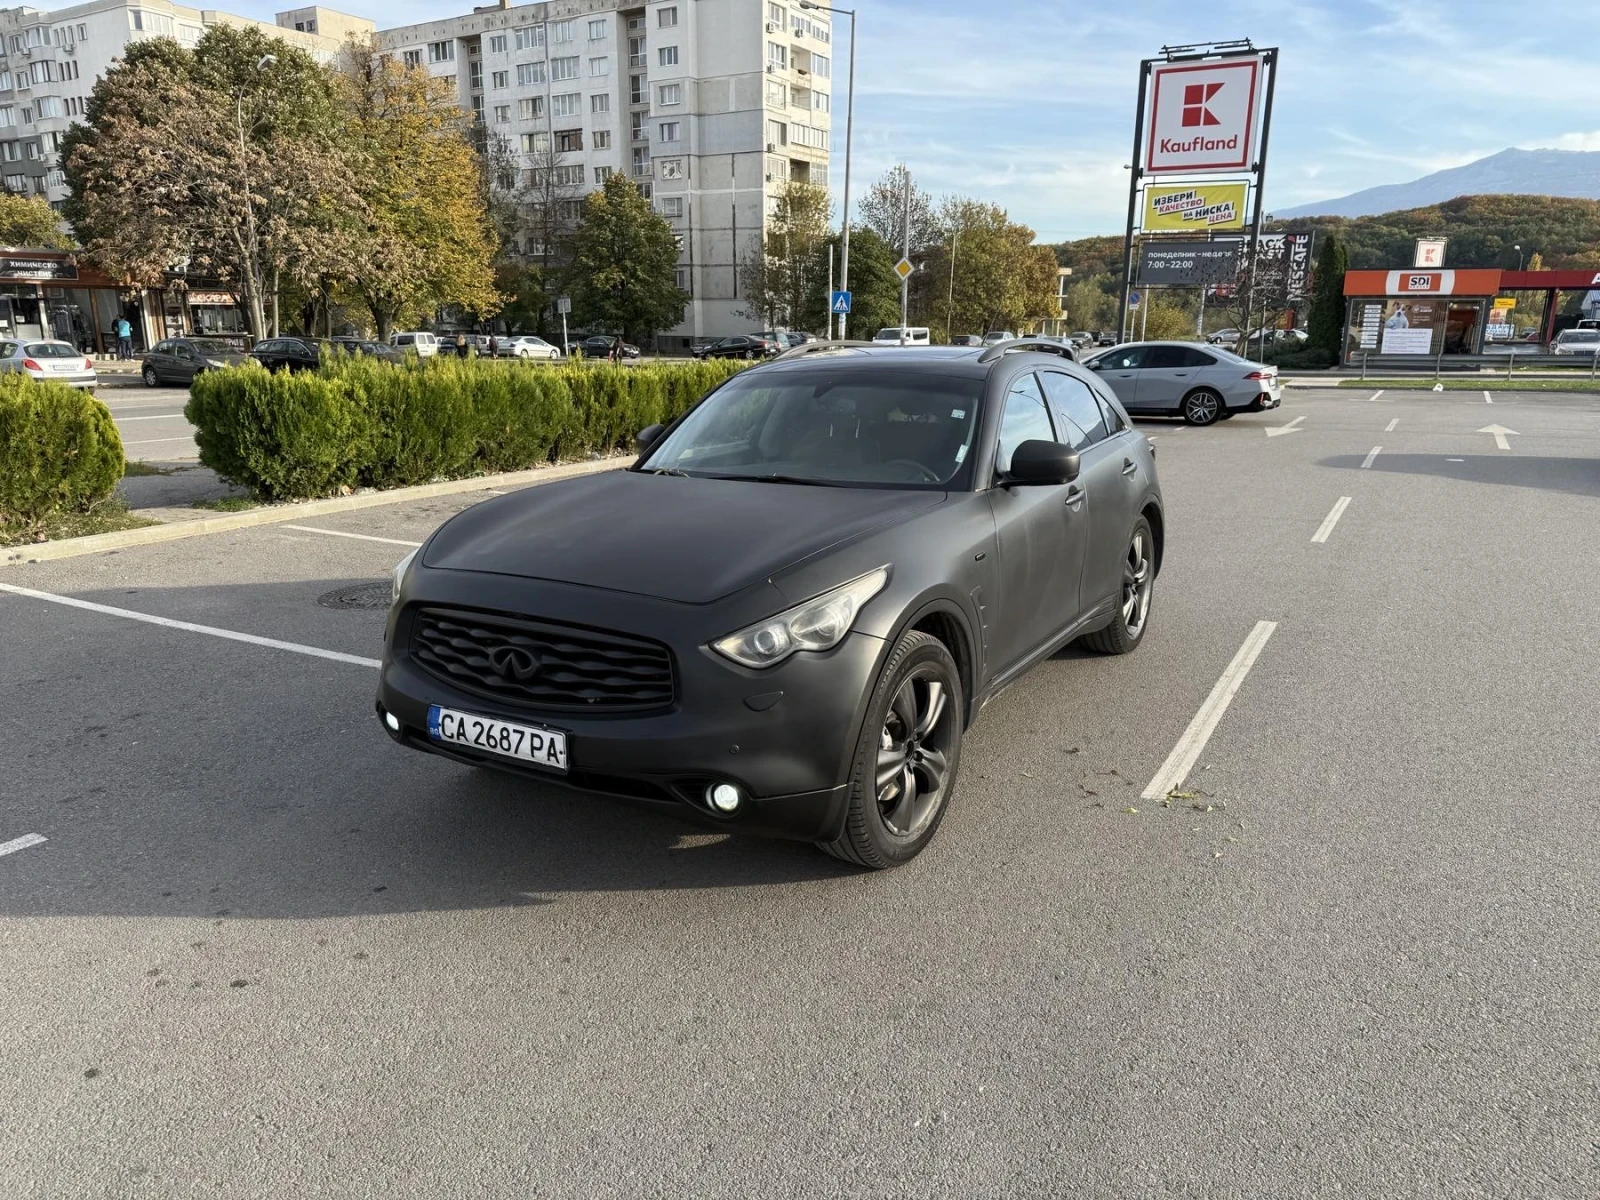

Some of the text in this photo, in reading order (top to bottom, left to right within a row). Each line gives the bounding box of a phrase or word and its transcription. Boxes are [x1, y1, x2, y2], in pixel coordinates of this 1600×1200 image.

[1160, 134, 1238, 153] Kaufland
[1154, 191, 1193, 206] ИЗБЕРИ
[1159, 199, 1203, 213] КАЧЕСТВО
[1195, 203, 1230, 218] НИСКА
[1208, 212, 1233, 223] ЦЕНА
[10, 261, 58, 269] ХИМИЧЕСКО
[1410, 276, 1430, 286] SDI
